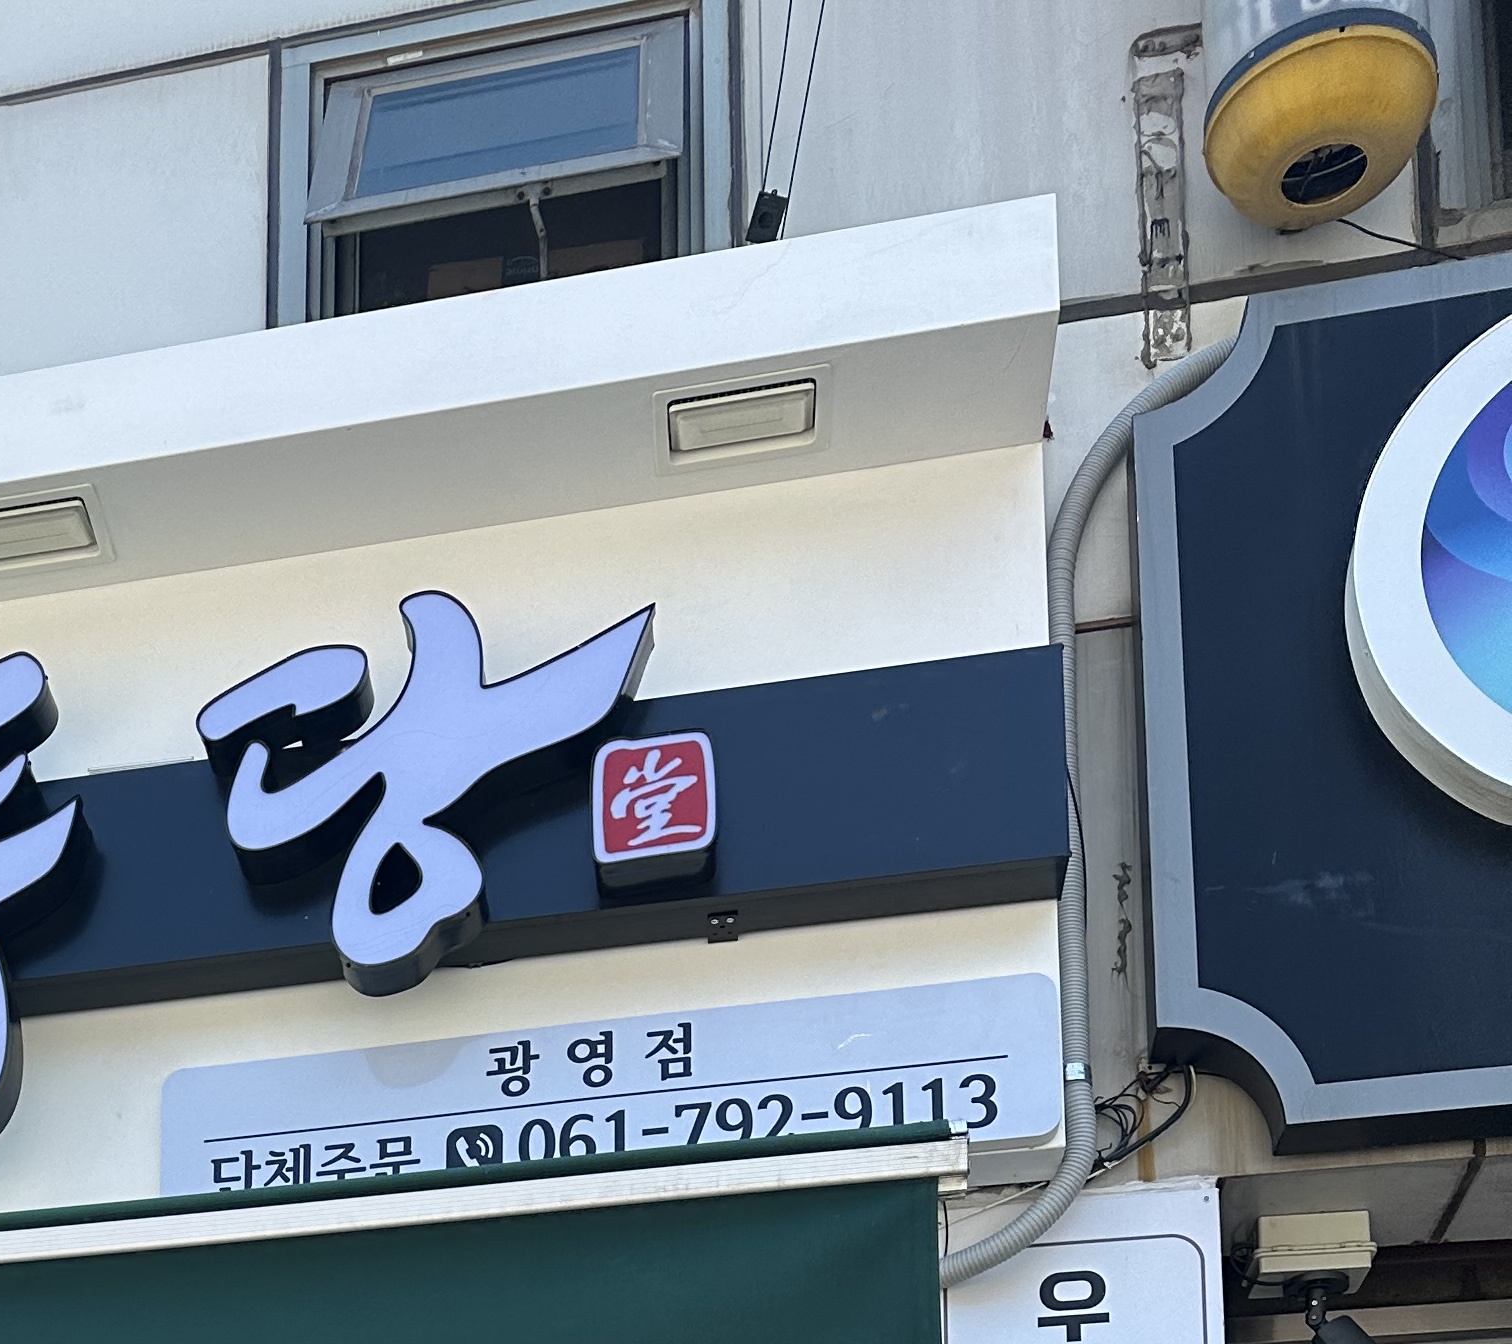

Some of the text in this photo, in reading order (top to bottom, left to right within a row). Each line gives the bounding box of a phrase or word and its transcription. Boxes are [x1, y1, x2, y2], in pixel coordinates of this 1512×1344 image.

[609, 748, 703, 847] 堂
[485, 1021, 695, 1098] 광영점
[518, 1072, 1000, 1165] 061-792-9113
